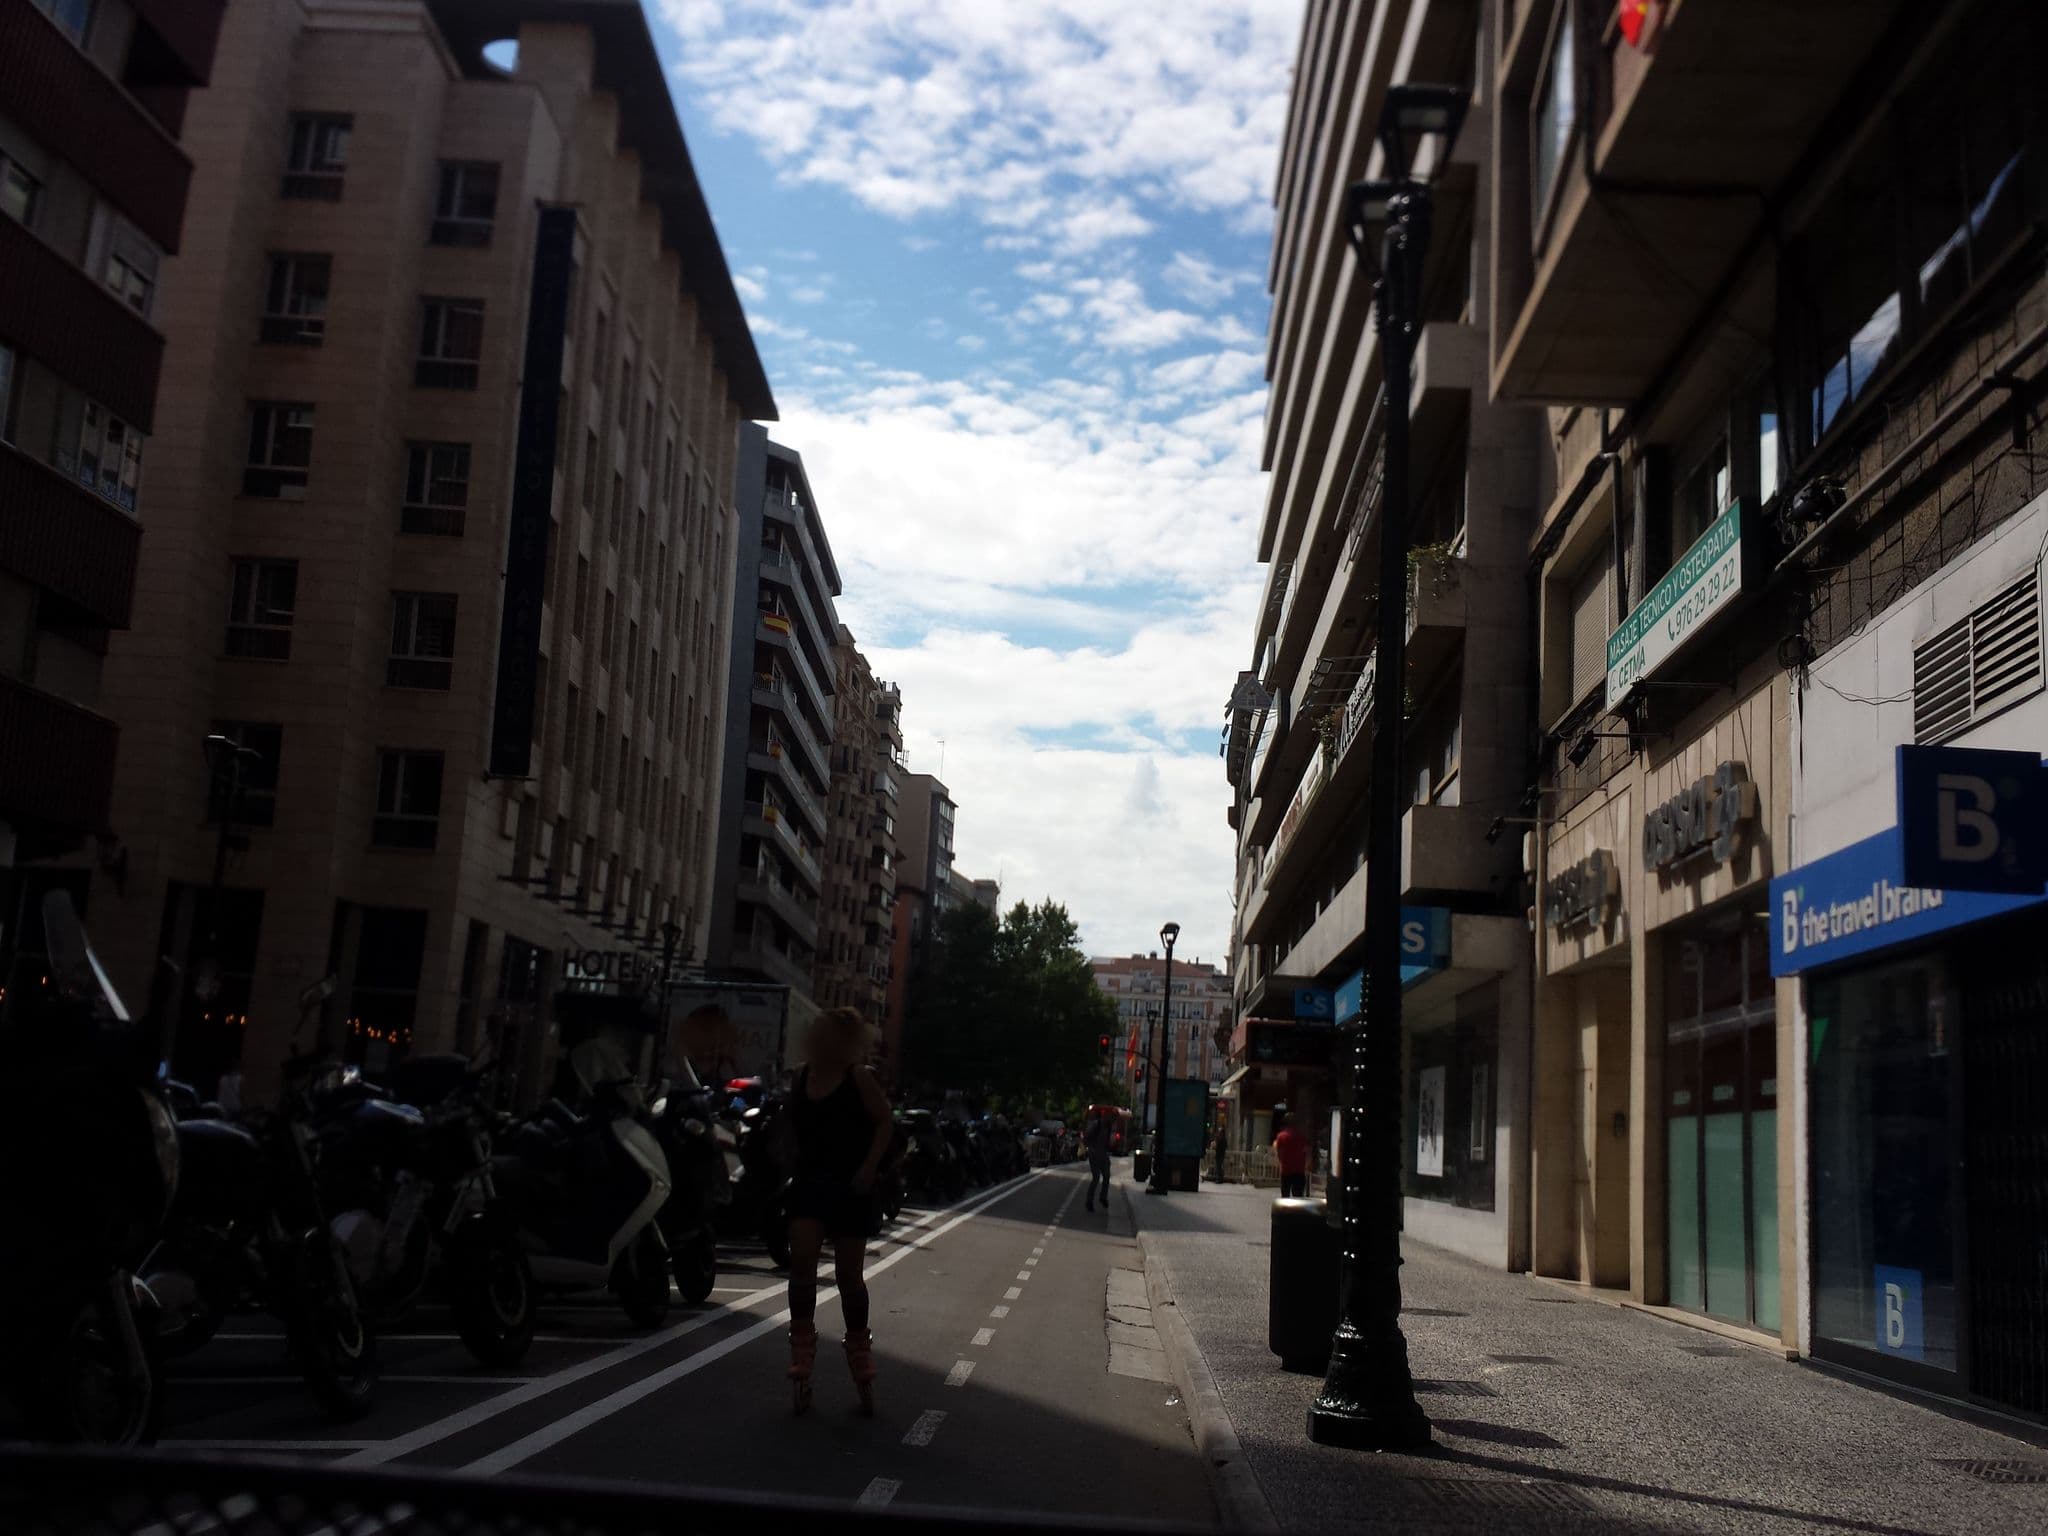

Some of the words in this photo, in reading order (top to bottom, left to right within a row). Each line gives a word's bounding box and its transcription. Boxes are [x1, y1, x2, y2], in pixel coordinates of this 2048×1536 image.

[1672, 575, 1679, 598] Y
[1676, 597, 1692, 636] 976
[1694, 586, 1705, 618] 29
[1708, 573, 1720, 605] 29
[1723, 557, 1735, 592] 22
[1618, 646, 1646, 688] CETMA
[1937, 772, 2000, 863] B
[1401, 921, 1426, 954] S
[1782, 889, 1800, 954] B
[1803, 906, 1828, 948] the
[1830, 882, 1879, 939] travel
[562, 948, 640, 980] HOTEL
[1885, 1282, 1905, 1350] B
